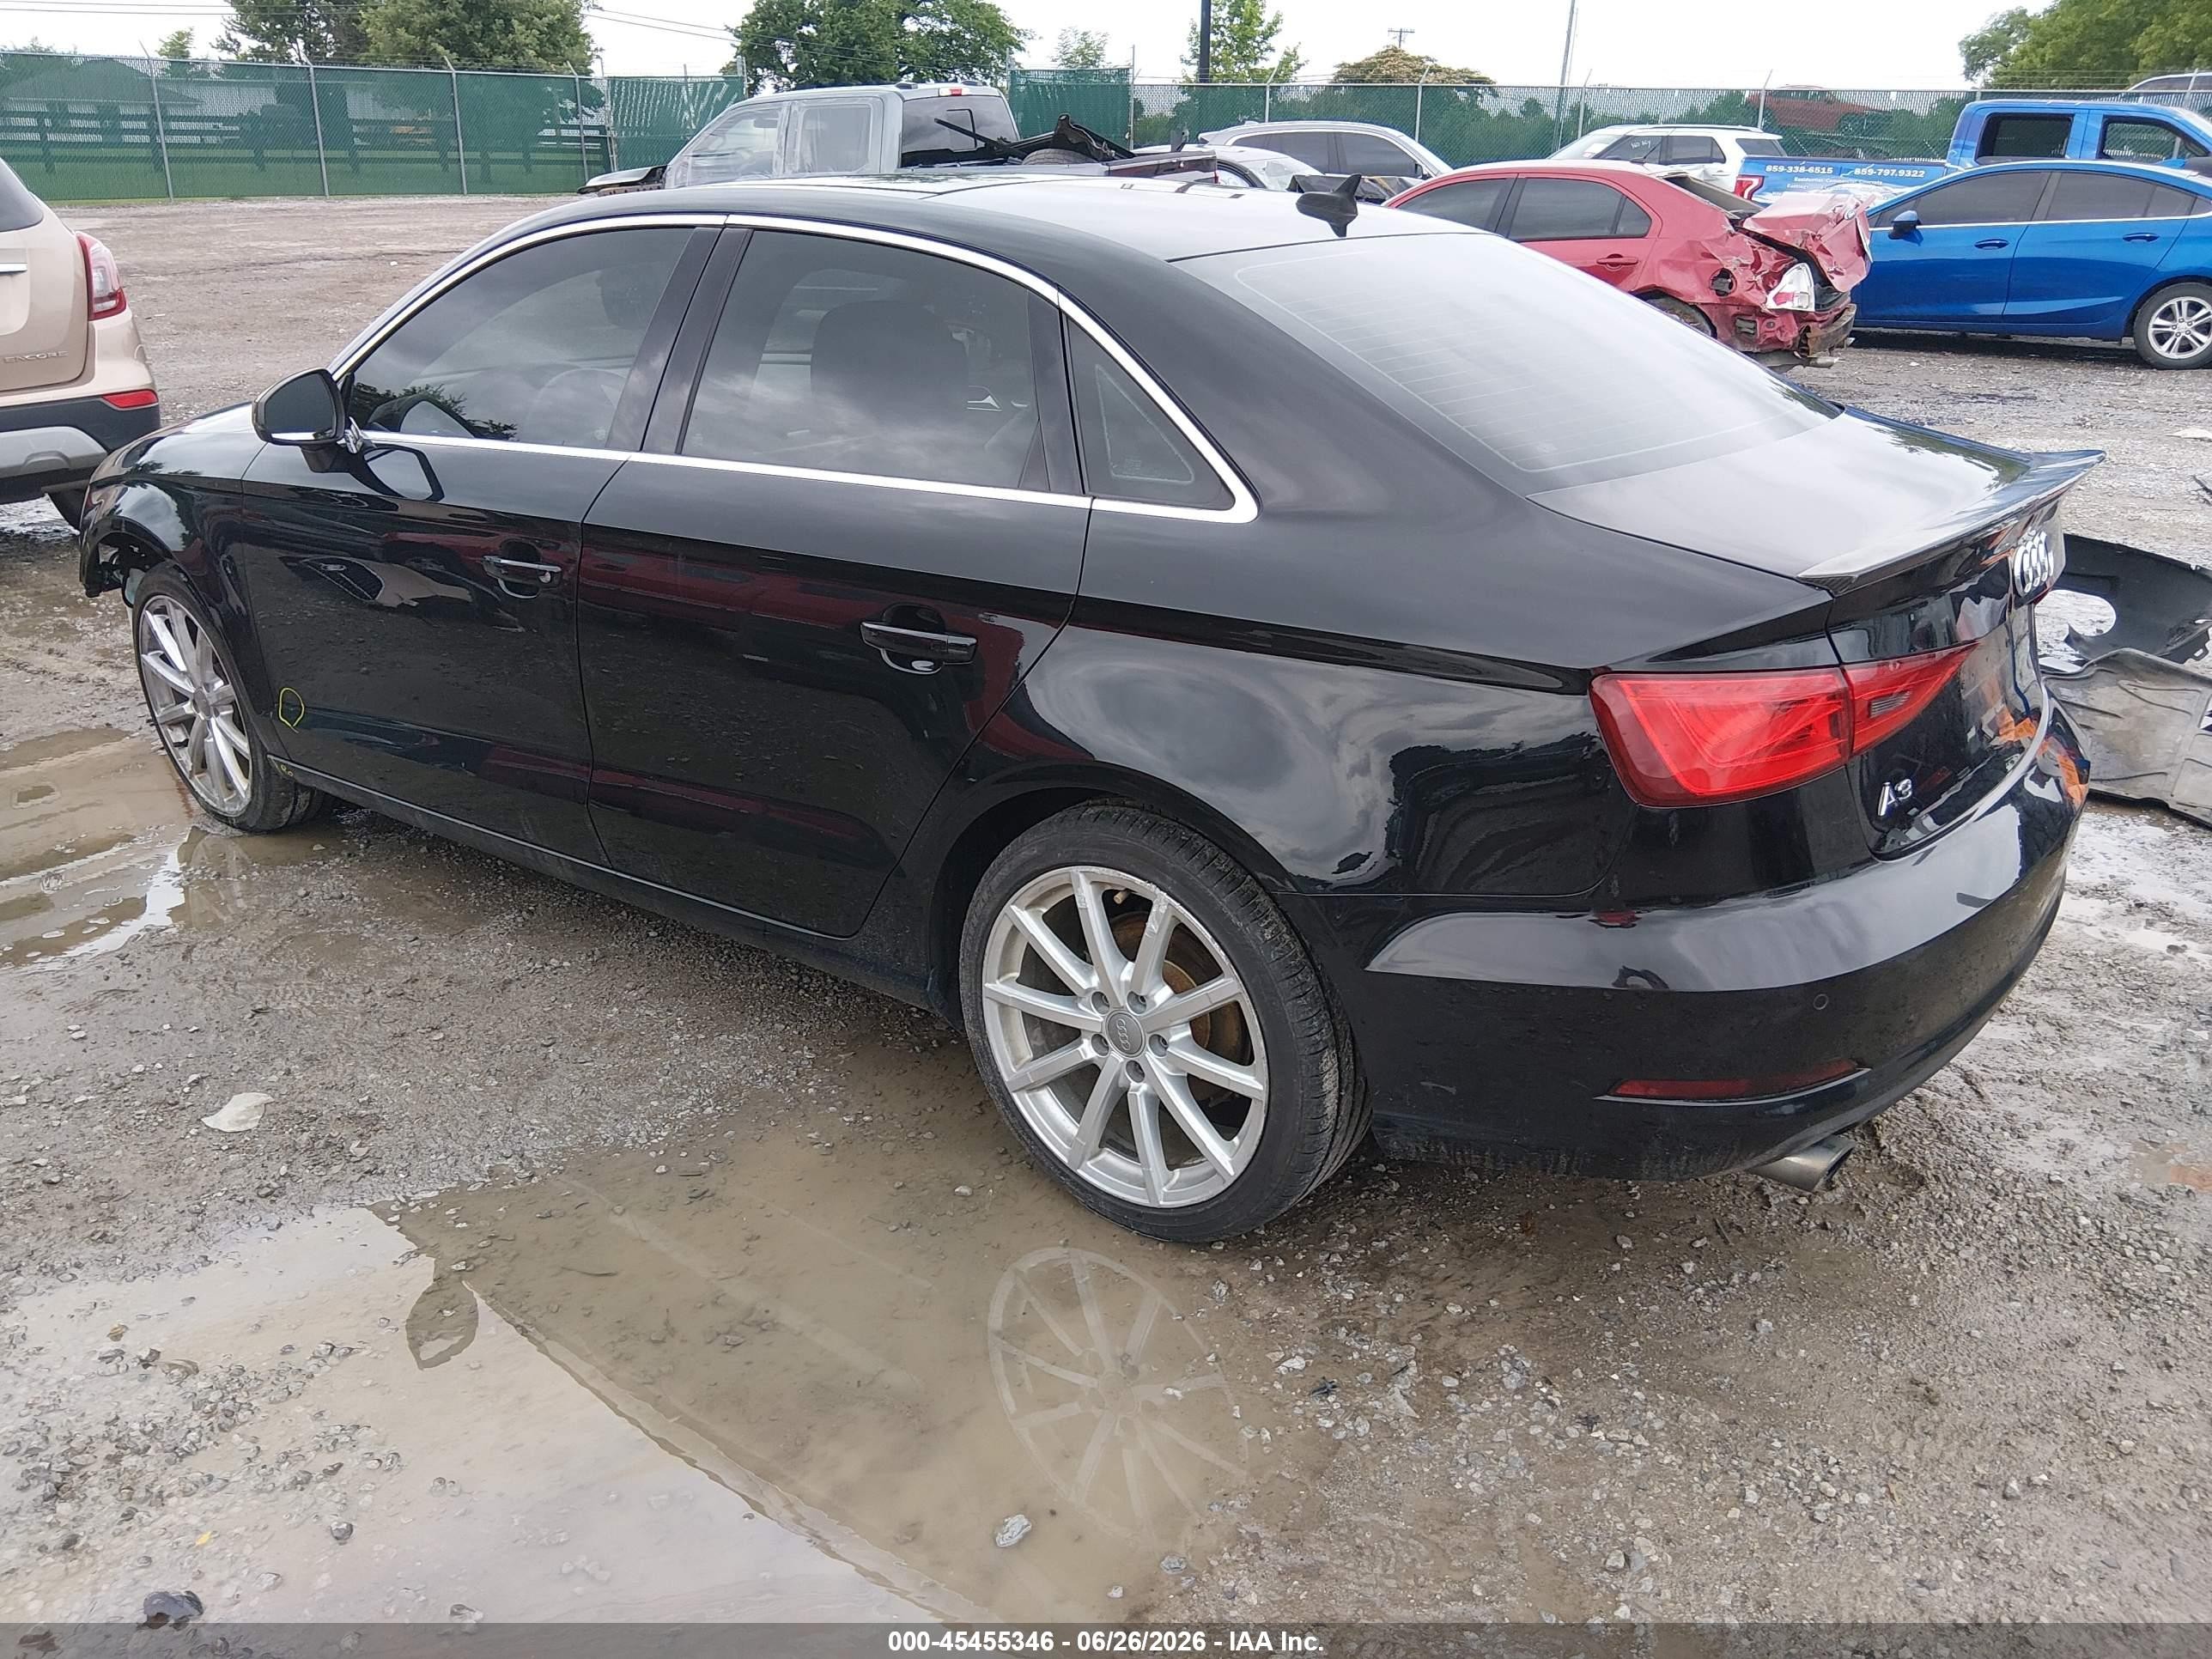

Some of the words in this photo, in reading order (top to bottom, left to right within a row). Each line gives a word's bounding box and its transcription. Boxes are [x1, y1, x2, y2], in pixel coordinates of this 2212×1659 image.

[1765, 165, 1833, 174] 859-338-6515
[1854, 167, 1925, 178] 859-797.9322
[3, 350, 70, 363] ENCORE
[1877, 778, 1913, 817] A3
